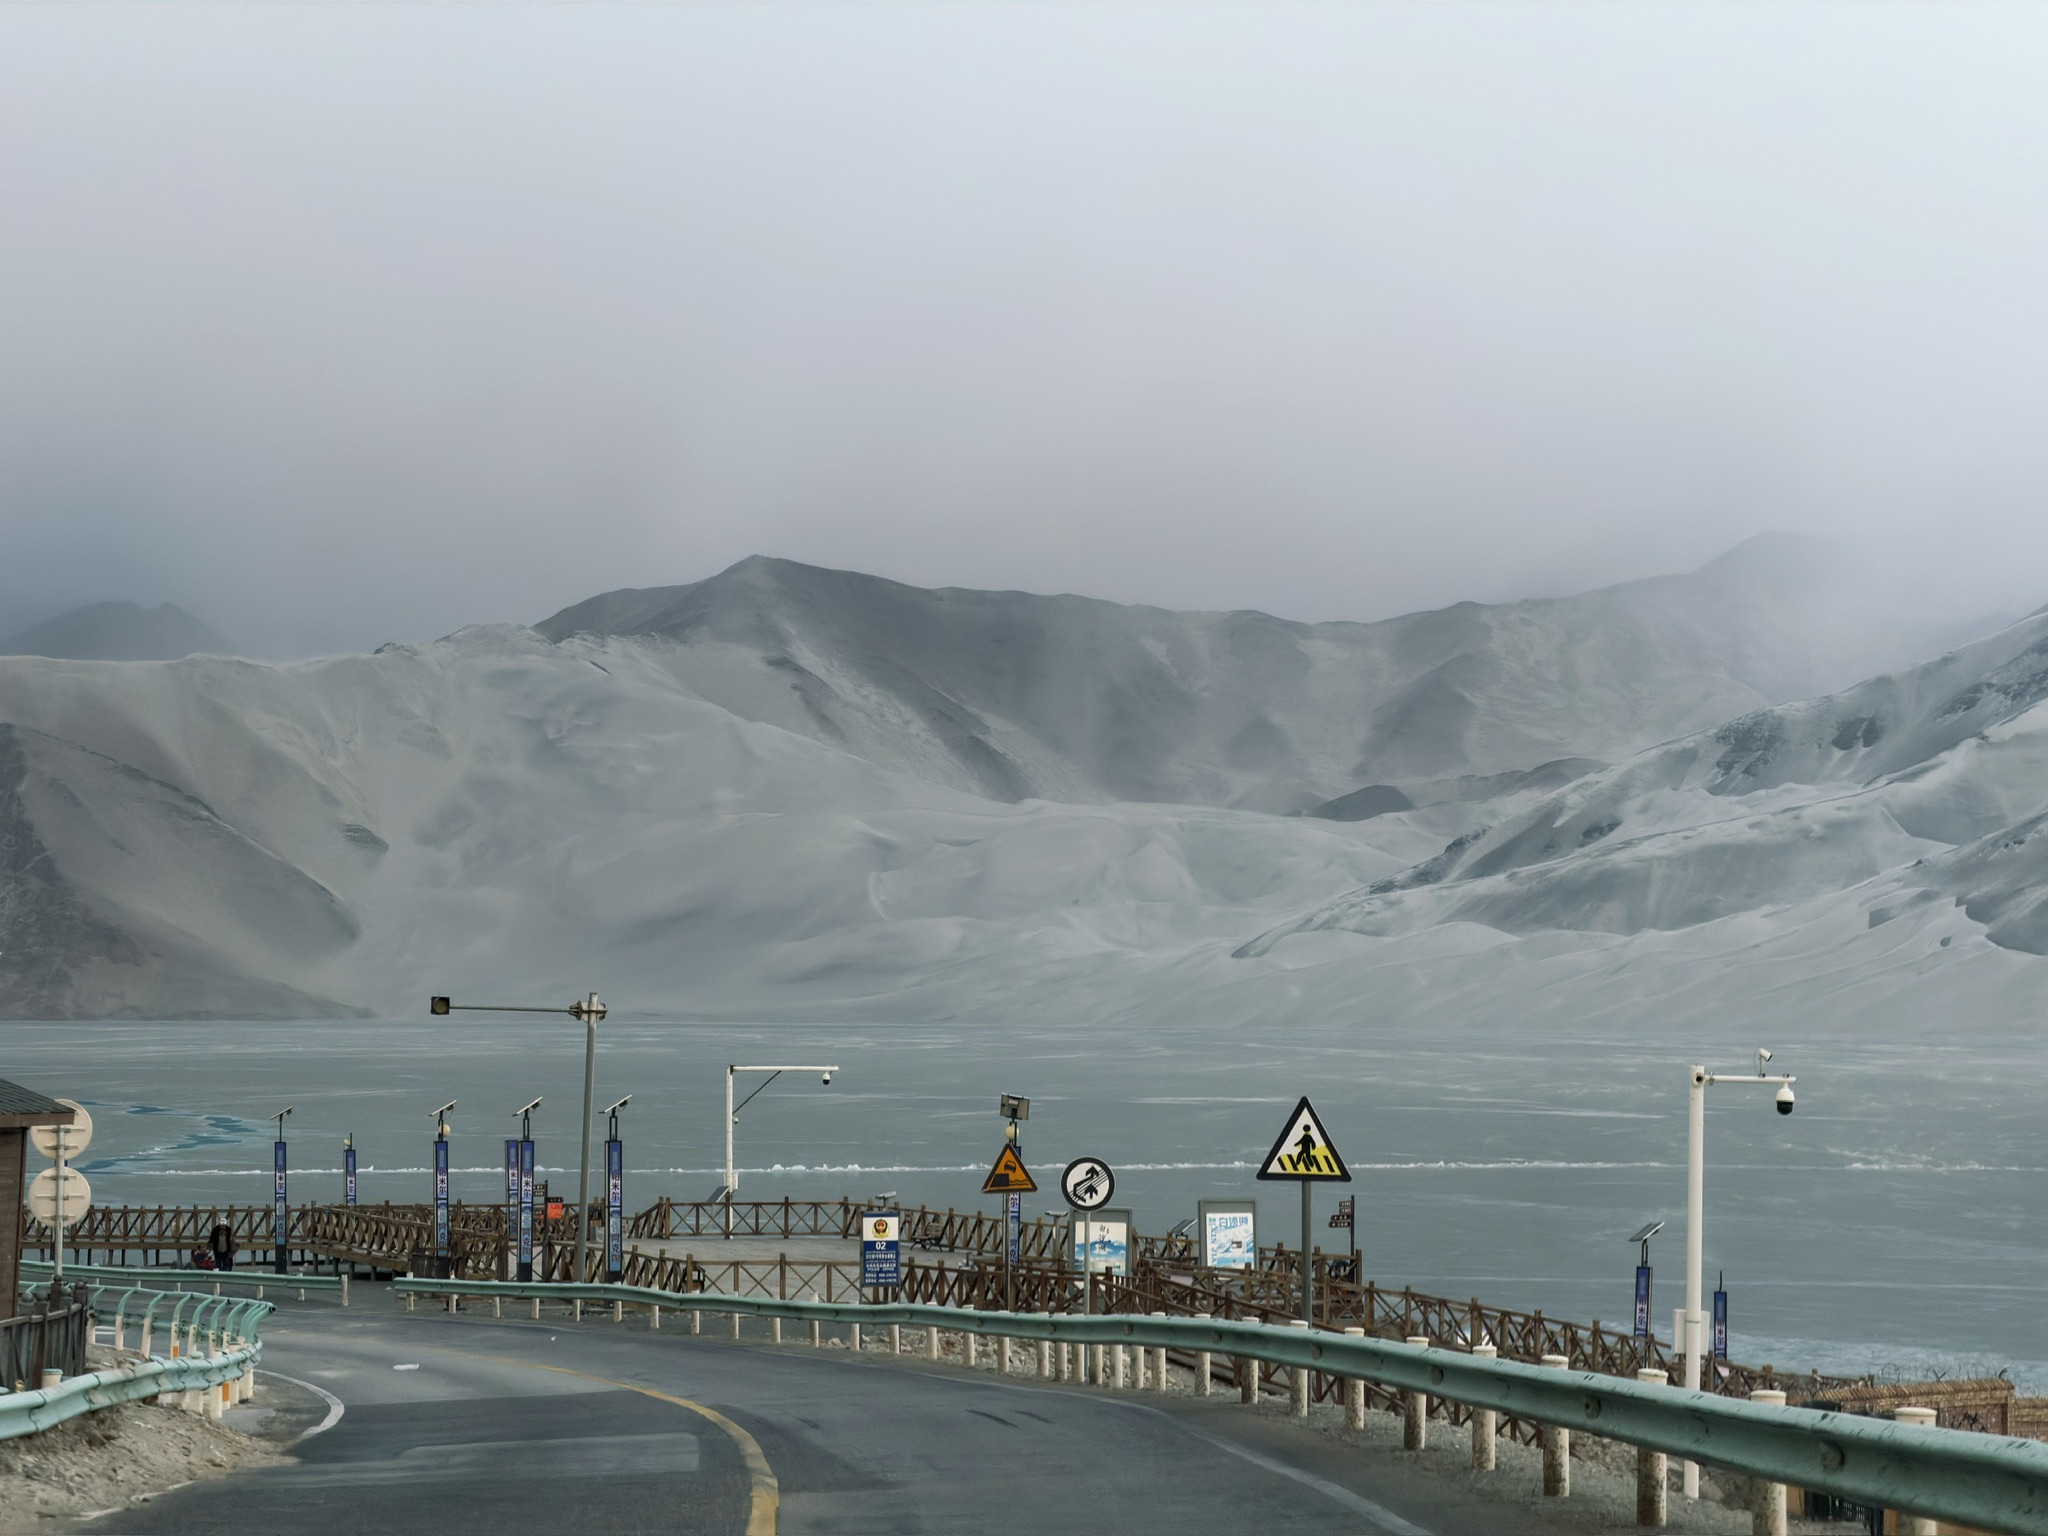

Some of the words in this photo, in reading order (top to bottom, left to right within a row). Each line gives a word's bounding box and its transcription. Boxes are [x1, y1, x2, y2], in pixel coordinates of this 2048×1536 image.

[523, 1170, 532, 1198] 帕米尔
[611, 1172, 620, 1201] 帕米尔
[875, 1241, 887, 1251] 02
